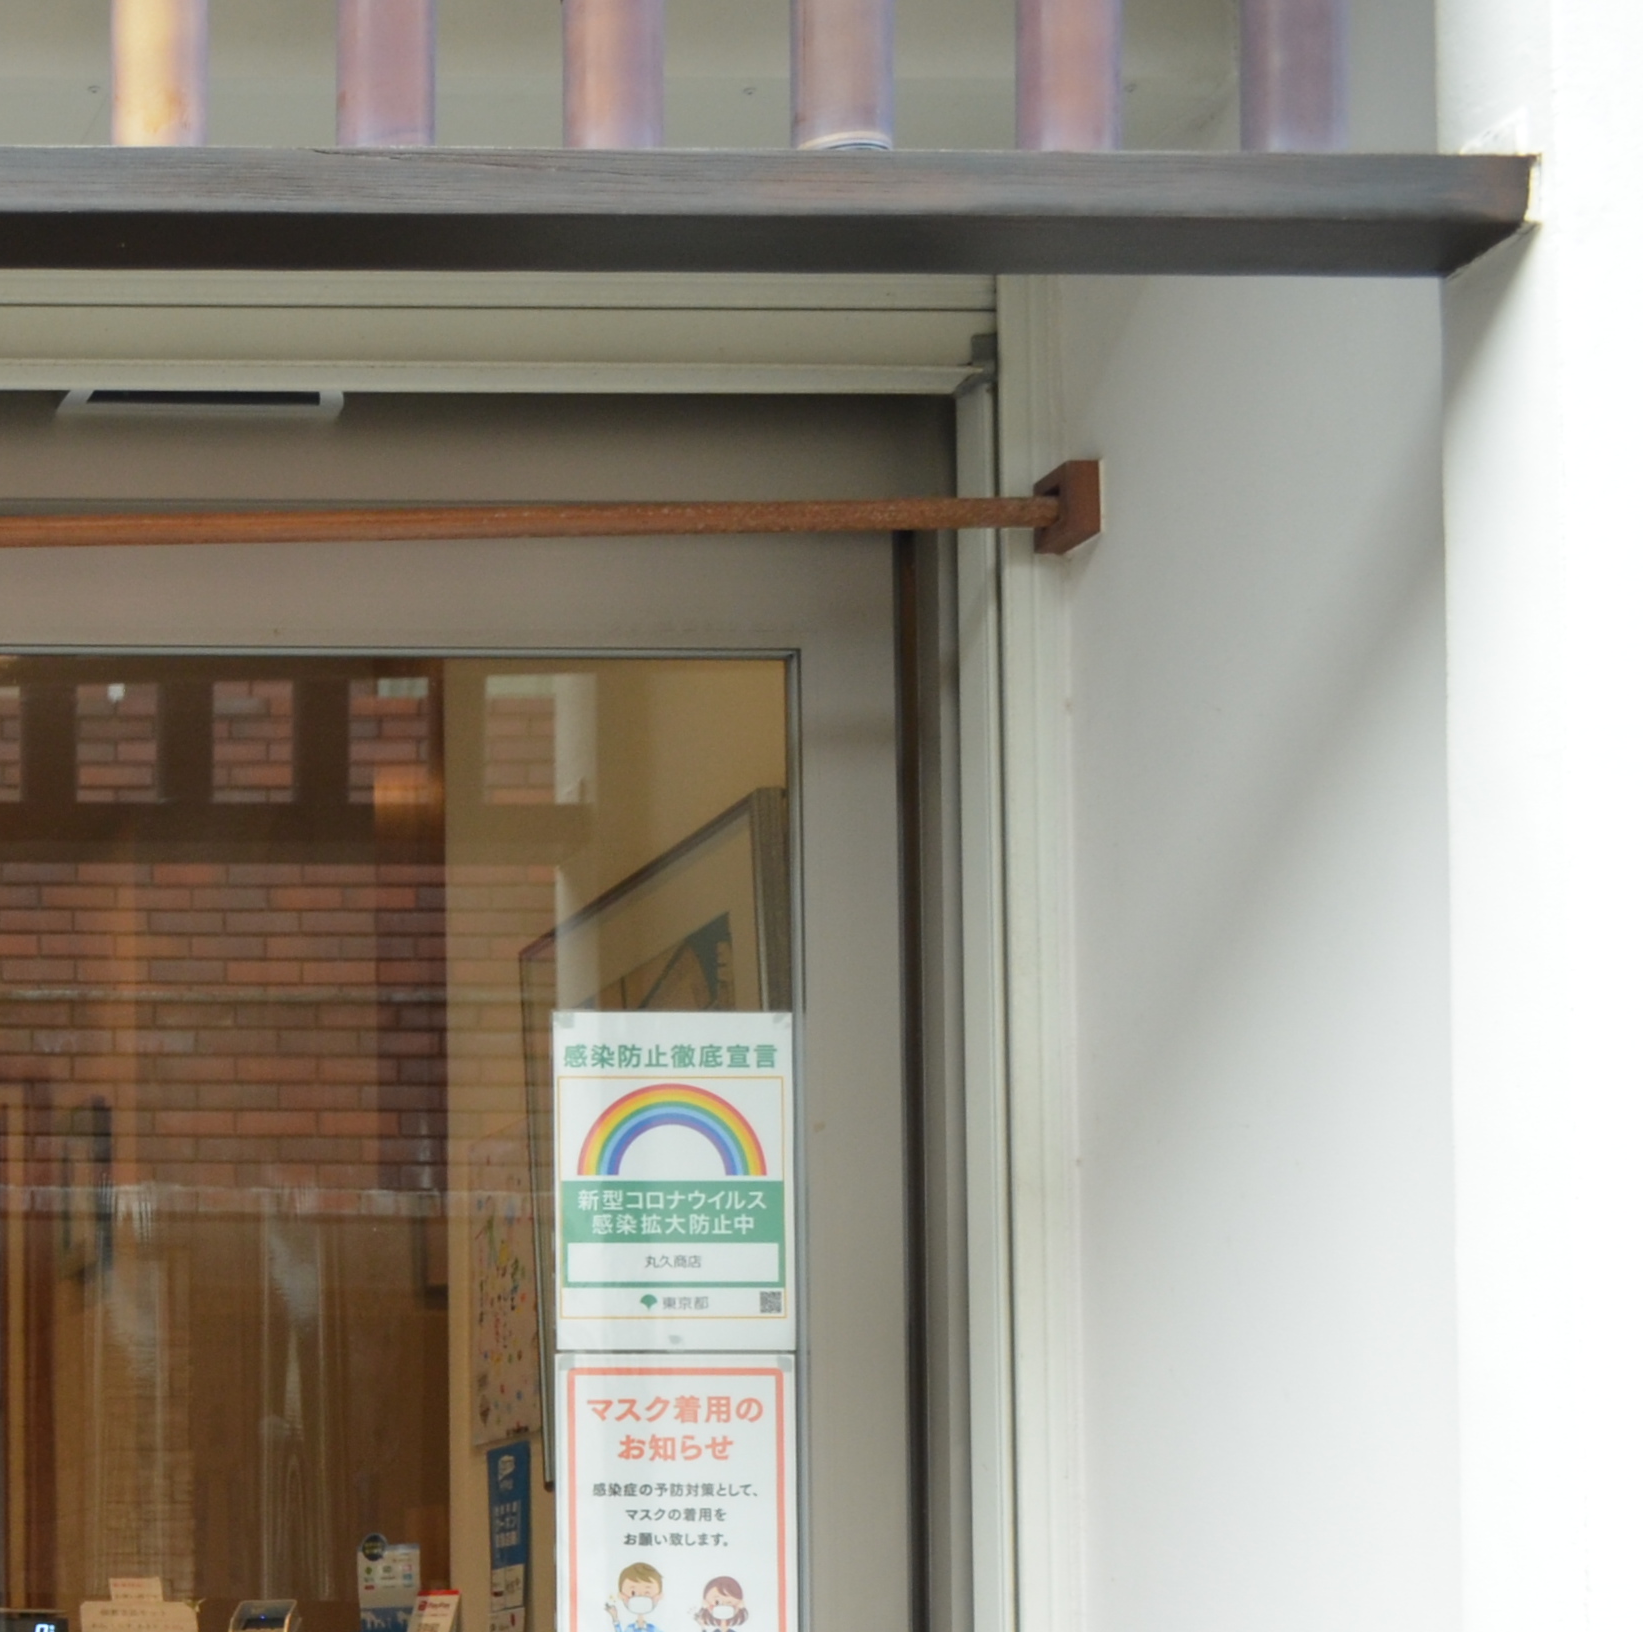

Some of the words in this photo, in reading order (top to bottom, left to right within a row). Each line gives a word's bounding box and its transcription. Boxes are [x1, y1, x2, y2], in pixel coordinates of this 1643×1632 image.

[563, 1043, 778, 1069] 感染防止徹底宣言
[577, 1189, 768, 1212] 新型コロナウイルス
[591, 1213, 756, 1236] 感染拡大防止中
[644, 1254, 703, 1270] 丸久商店
[661, 1295, 710, 1311] 東京都
[586, 1395, 765, 1424] マスク着用の
[617, 1434, 734, 1462] お知らせ
[592, 1482, 760, 1498] 感染症の予防対策として、
[625, 1507, 728, 1523] マスクの着用を
[623, 1532, 730, 1548] お願い致します。
